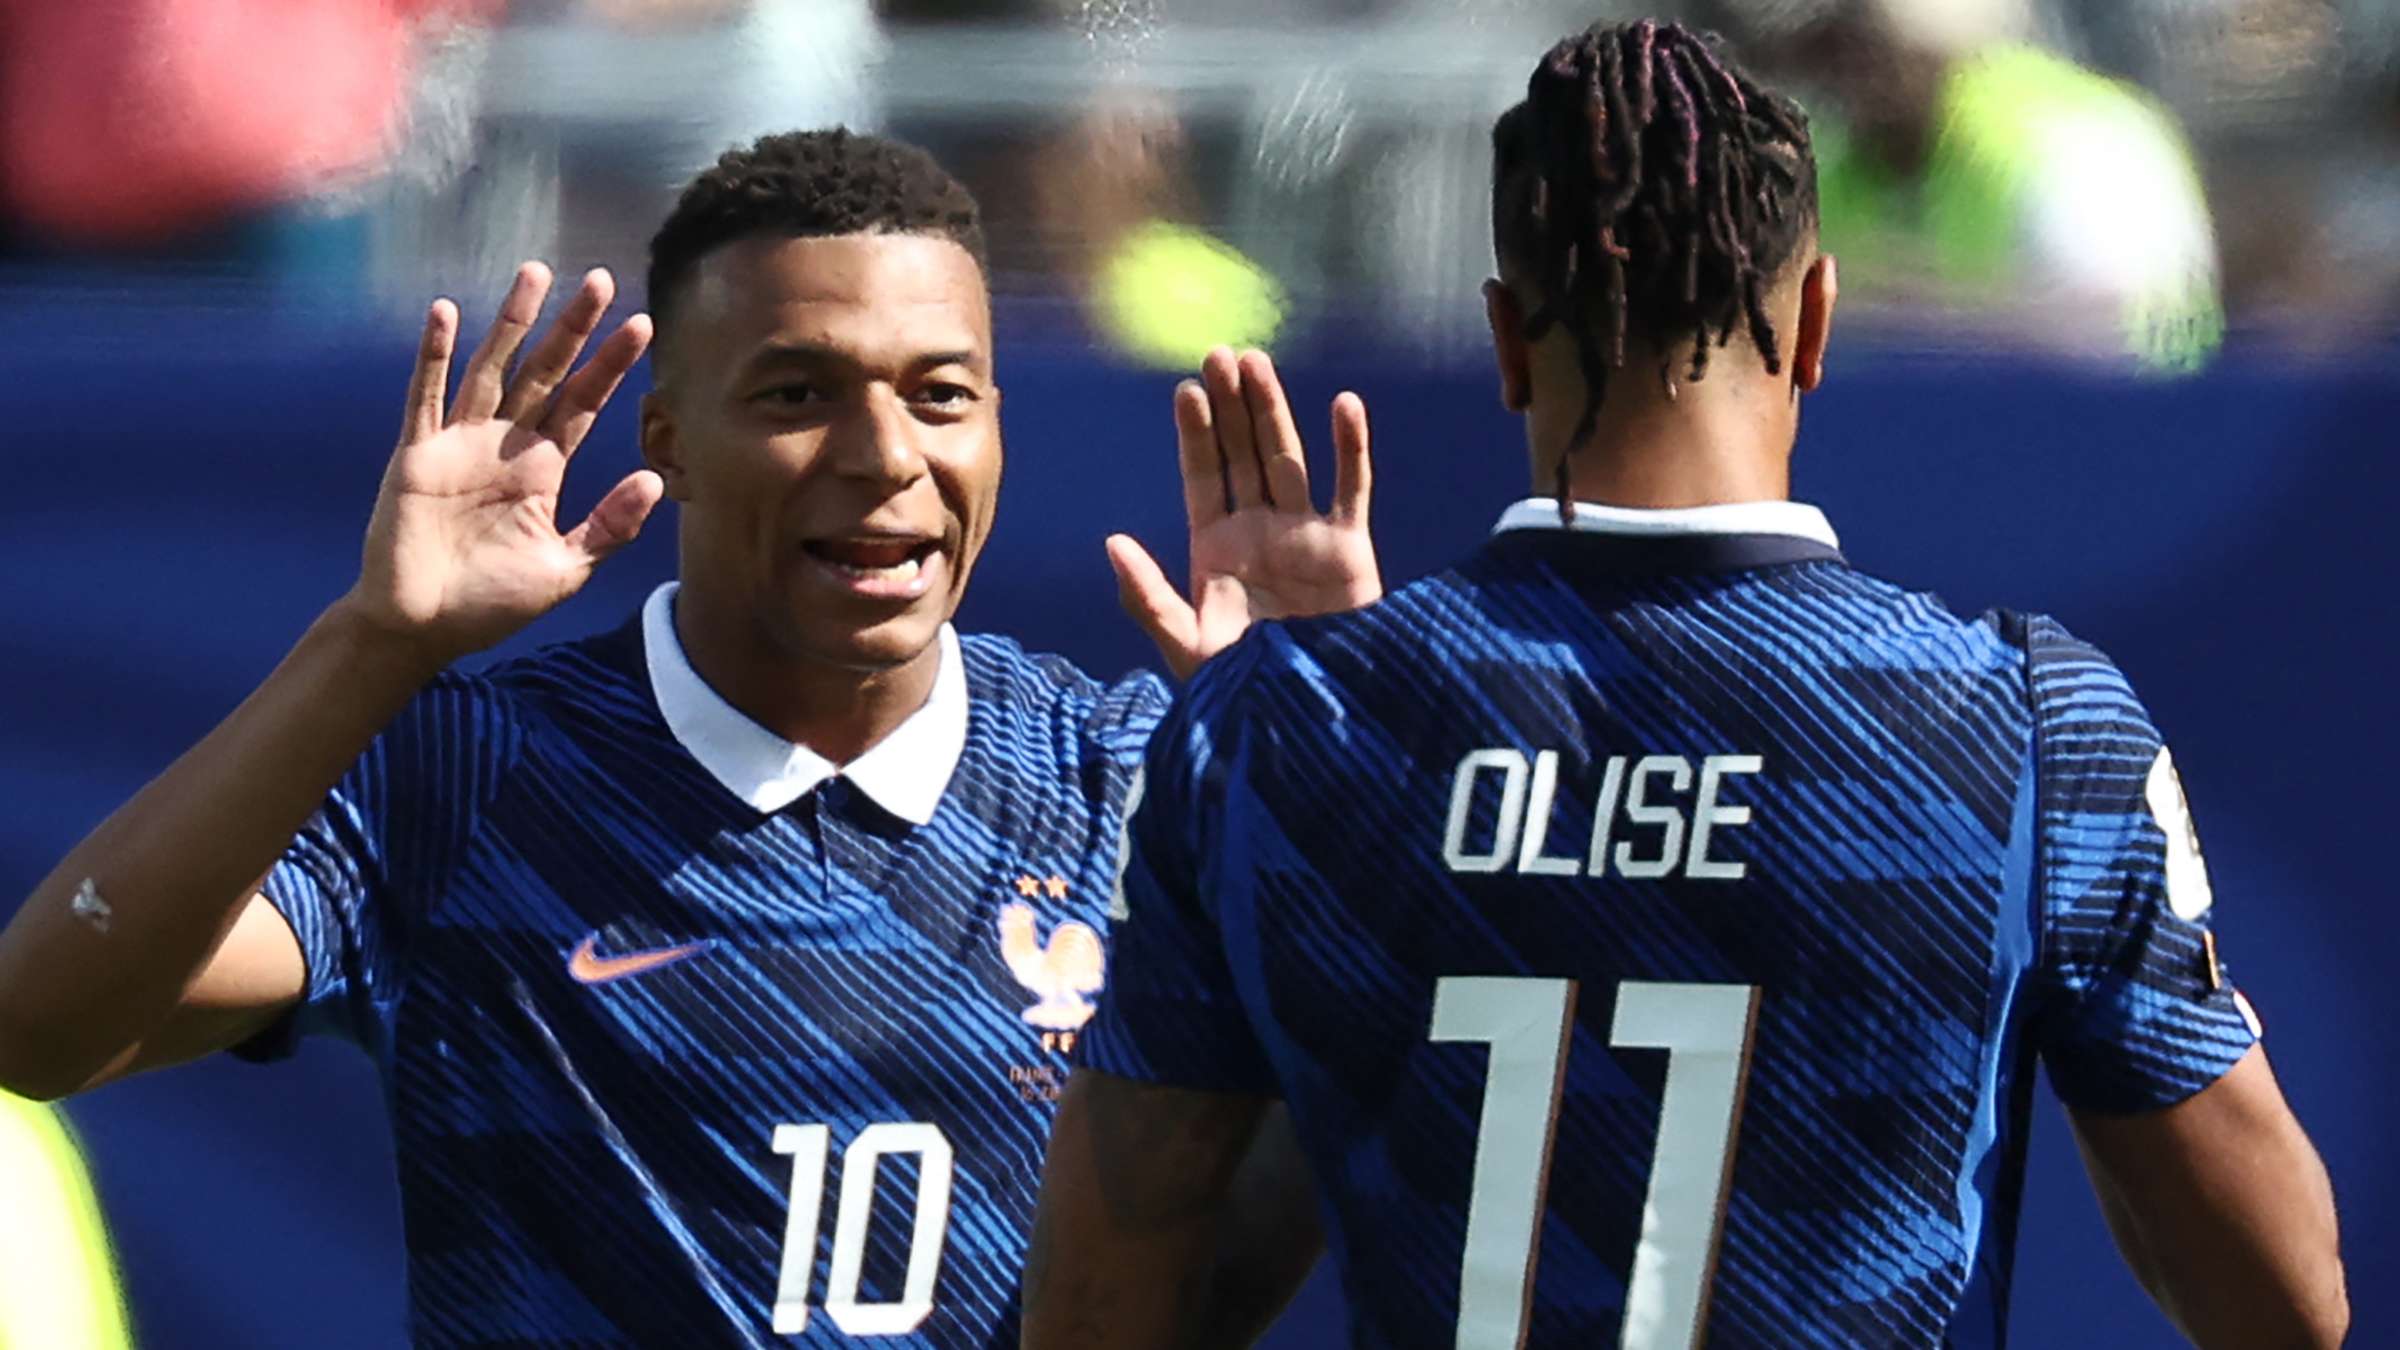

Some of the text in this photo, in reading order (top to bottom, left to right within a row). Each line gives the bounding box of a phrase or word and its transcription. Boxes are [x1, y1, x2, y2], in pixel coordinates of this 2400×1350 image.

[1443, 748, 1763, 879] OLISE
[771, 1121, 954, 1336] 10
[1428, 976, 1763, 1350] 11
